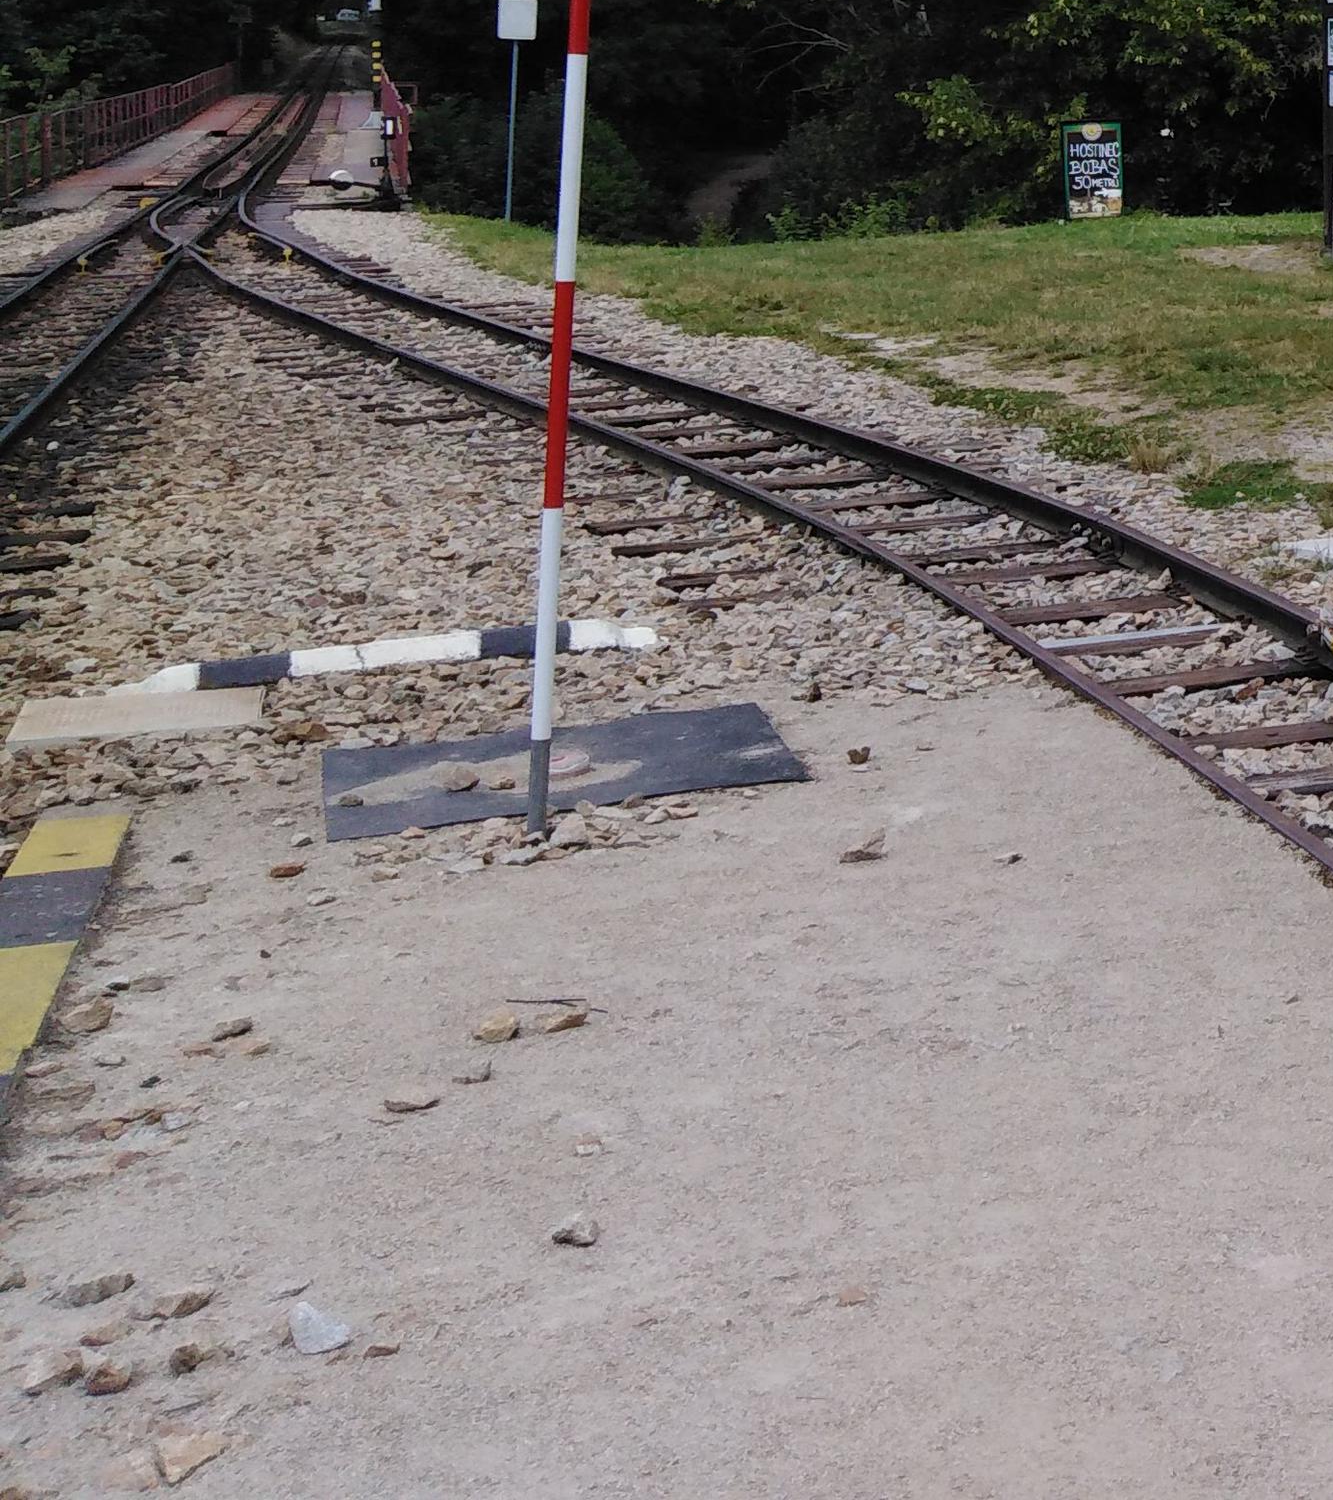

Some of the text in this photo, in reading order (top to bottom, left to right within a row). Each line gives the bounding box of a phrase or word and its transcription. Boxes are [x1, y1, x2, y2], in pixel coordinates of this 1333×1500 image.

[1069, 142, 1121, 157] HOSTINEC
[1069, 158, 1119, 175] BOBAS
[1072, 176, 1091, 190] 50
